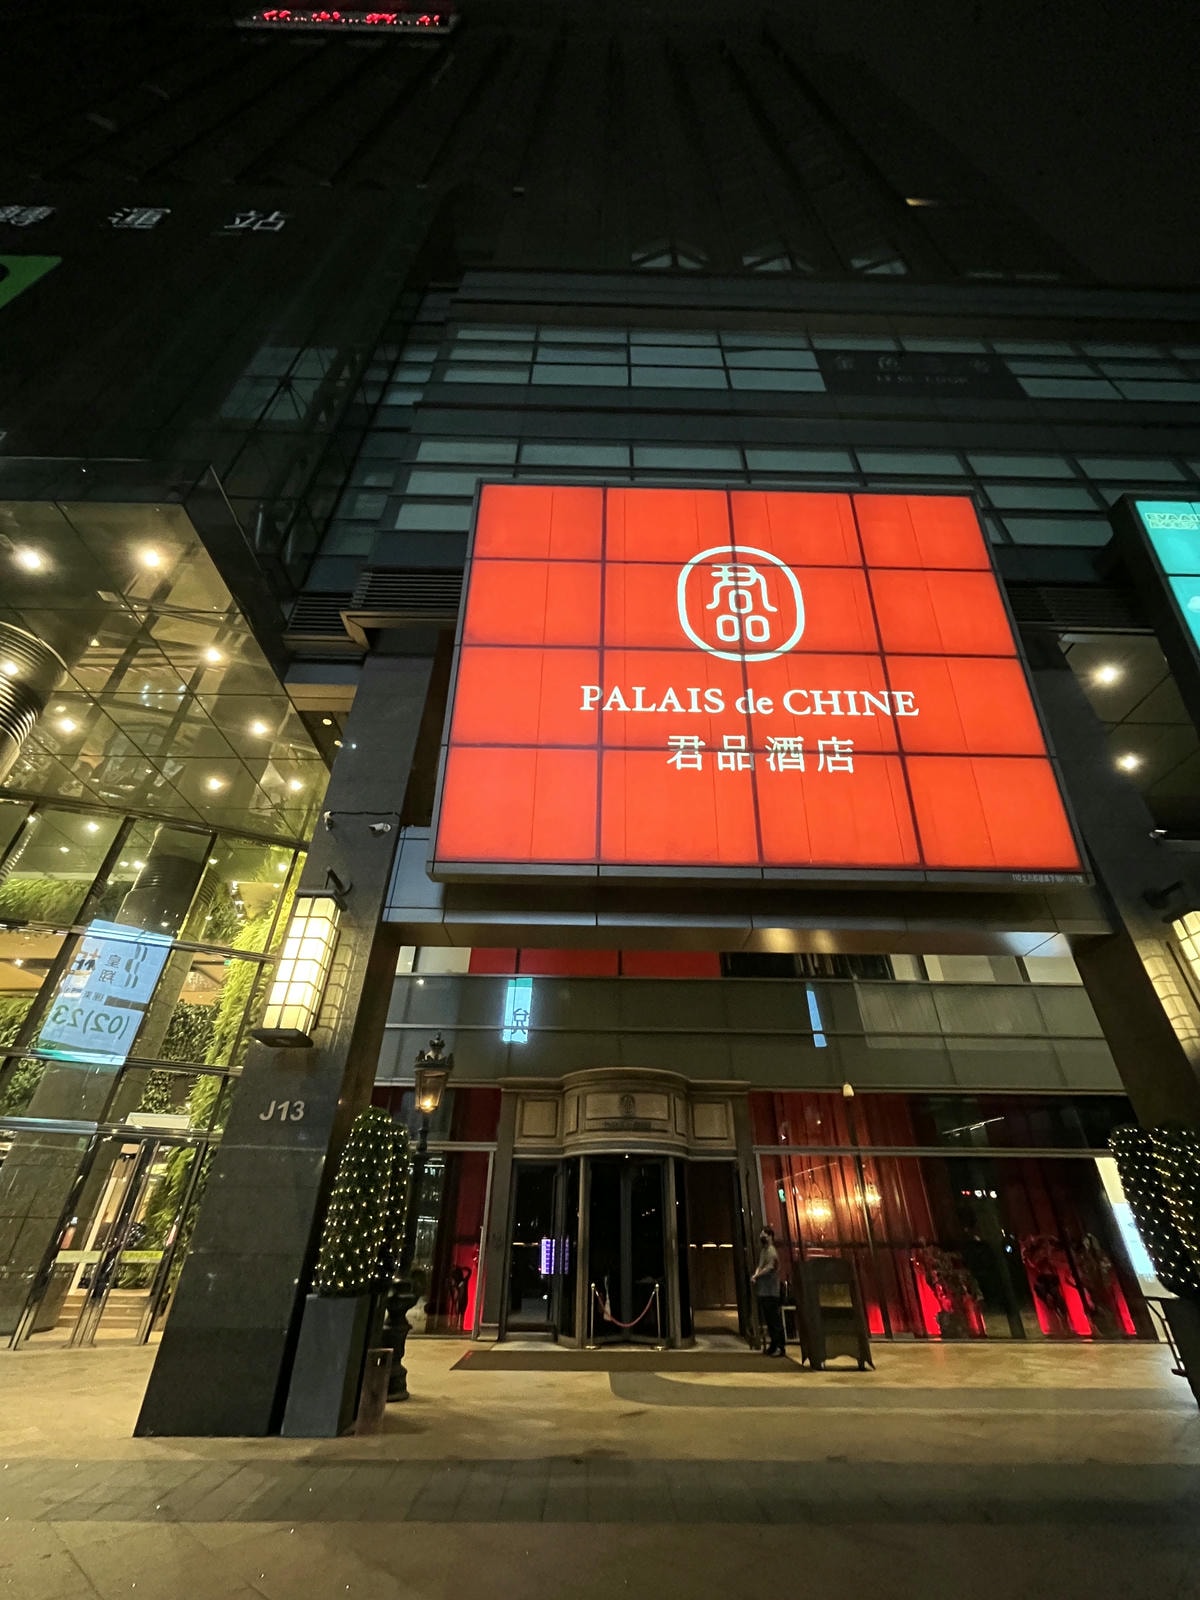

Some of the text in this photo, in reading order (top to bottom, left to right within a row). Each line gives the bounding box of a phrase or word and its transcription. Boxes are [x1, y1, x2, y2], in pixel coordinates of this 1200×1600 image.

[579, 685, 920, 717] PALAIS de CHINE
[666, 734, 855, 774] 君品酒店
[259, 1100, 305, 1121] J13
